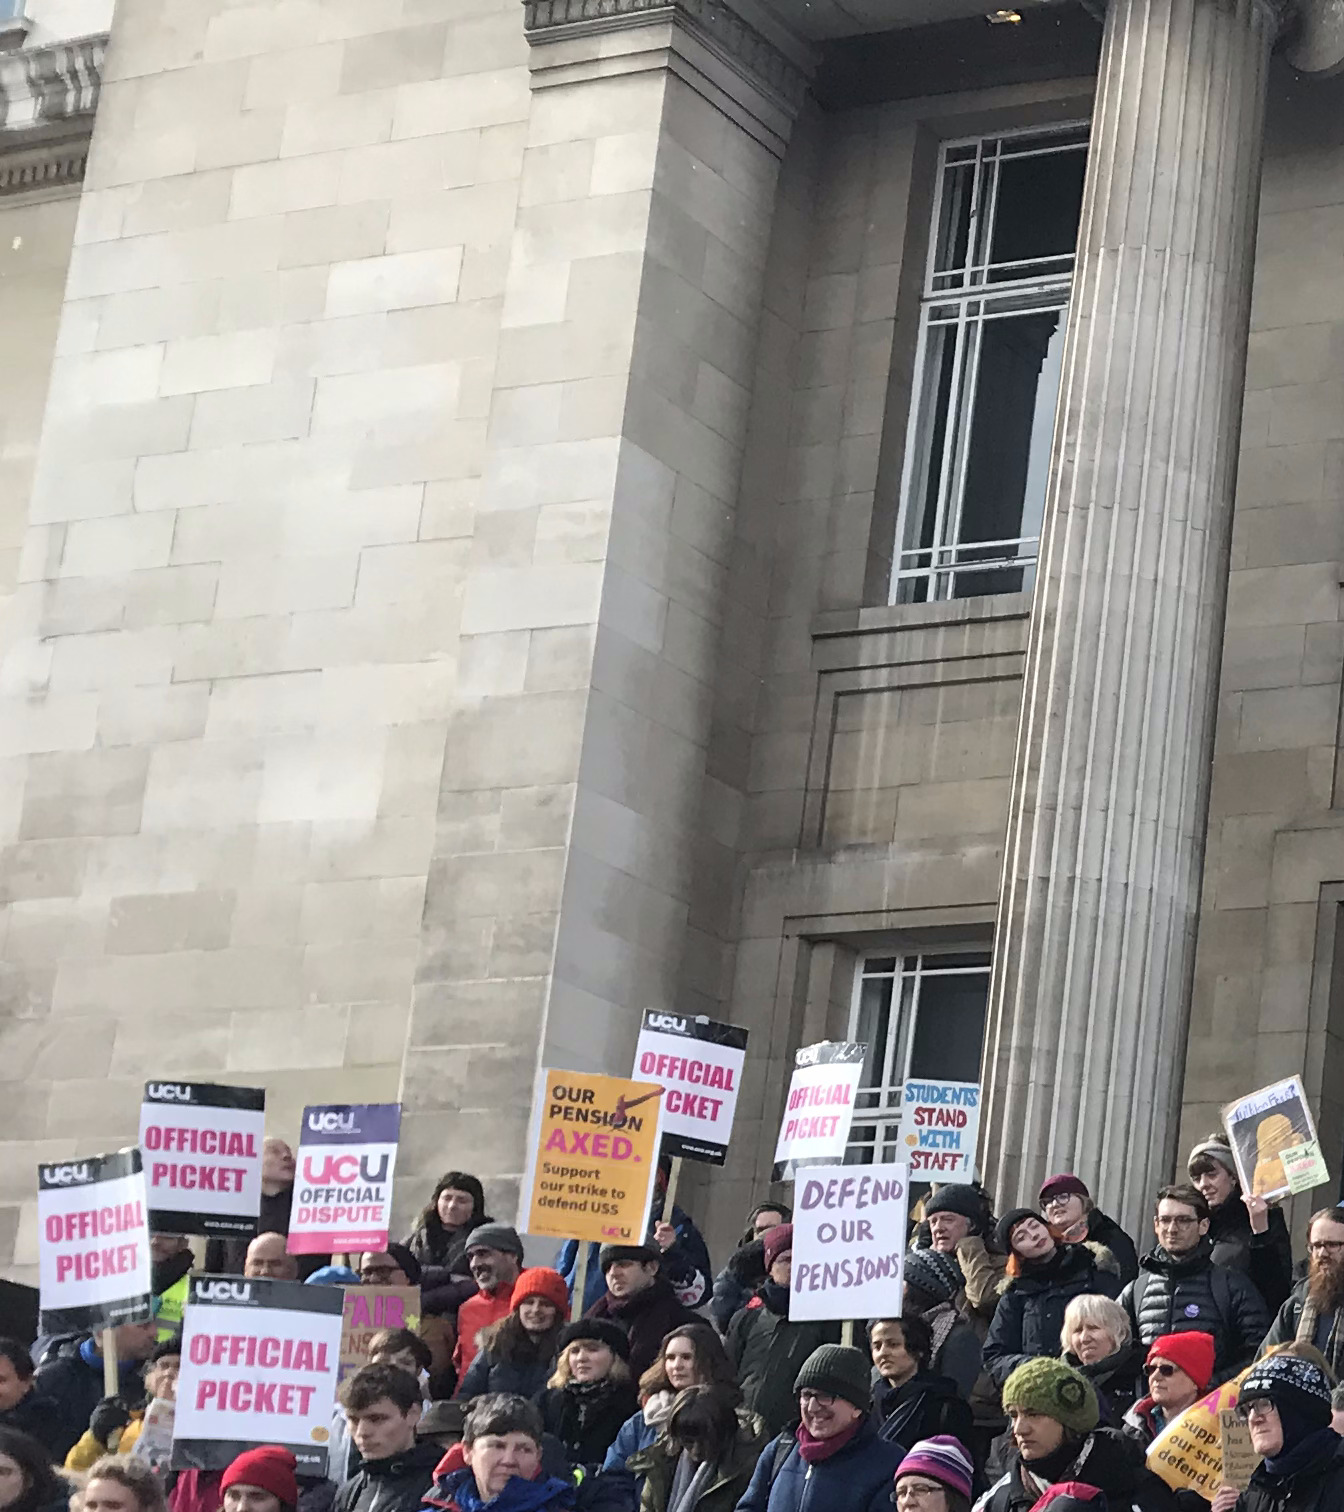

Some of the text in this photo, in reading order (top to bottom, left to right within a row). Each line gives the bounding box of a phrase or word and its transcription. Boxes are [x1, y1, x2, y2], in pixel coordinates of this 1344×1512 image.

[640, 1052, 735, 1092] OFFICIAL
[552, 1085, 595, 1104] OUR
[665, 1090, 723, 1122] CKET
[789, 1083, 851, 1113] OFFICIAL
[905, 1083, 980, 1107] STUDENTS
[549, 1104, 643, 1132] PENSION
[784, 1115, 841, 1142] PICKET
[914, 1106, 968, 1128] STAND
[145, 1126, 257, 1158] OFFICIAL
[545, 1128, 642, 1163] AXED.
[919, 1129, 961, 1149] WITH
[152, 1163, 248, 1193] PICKET
[543, 1162, 601, 1181] Support
[300, 1187, 386, 1204] OFFICIAL
[540, 1181, 626, 1200] our strike to
[800, 1175, 904, 1211] DEFEND
[296, 1205, 385, 1225] DISPUTE
[538, 1196, 619, 1216] defend USS
[46, 1200, 145, 1243] OFFICIAL
[816, 1219, 875, 1244] OUR
[56, 1243, 138, 1283] PICKET
[794, 1252, 900, 1294] PENSIONS
[189, 1334, 330, 1373] OFFICIAL
[195, 1380, 316, 1417] PICKET
[1181, 1419, 1223, 1450] Supp
[1157, 1449, 1209, 1487] defend
[1169, 1434, 1196, 1454] our
[1195, 1449, 1224, 1473] stri
